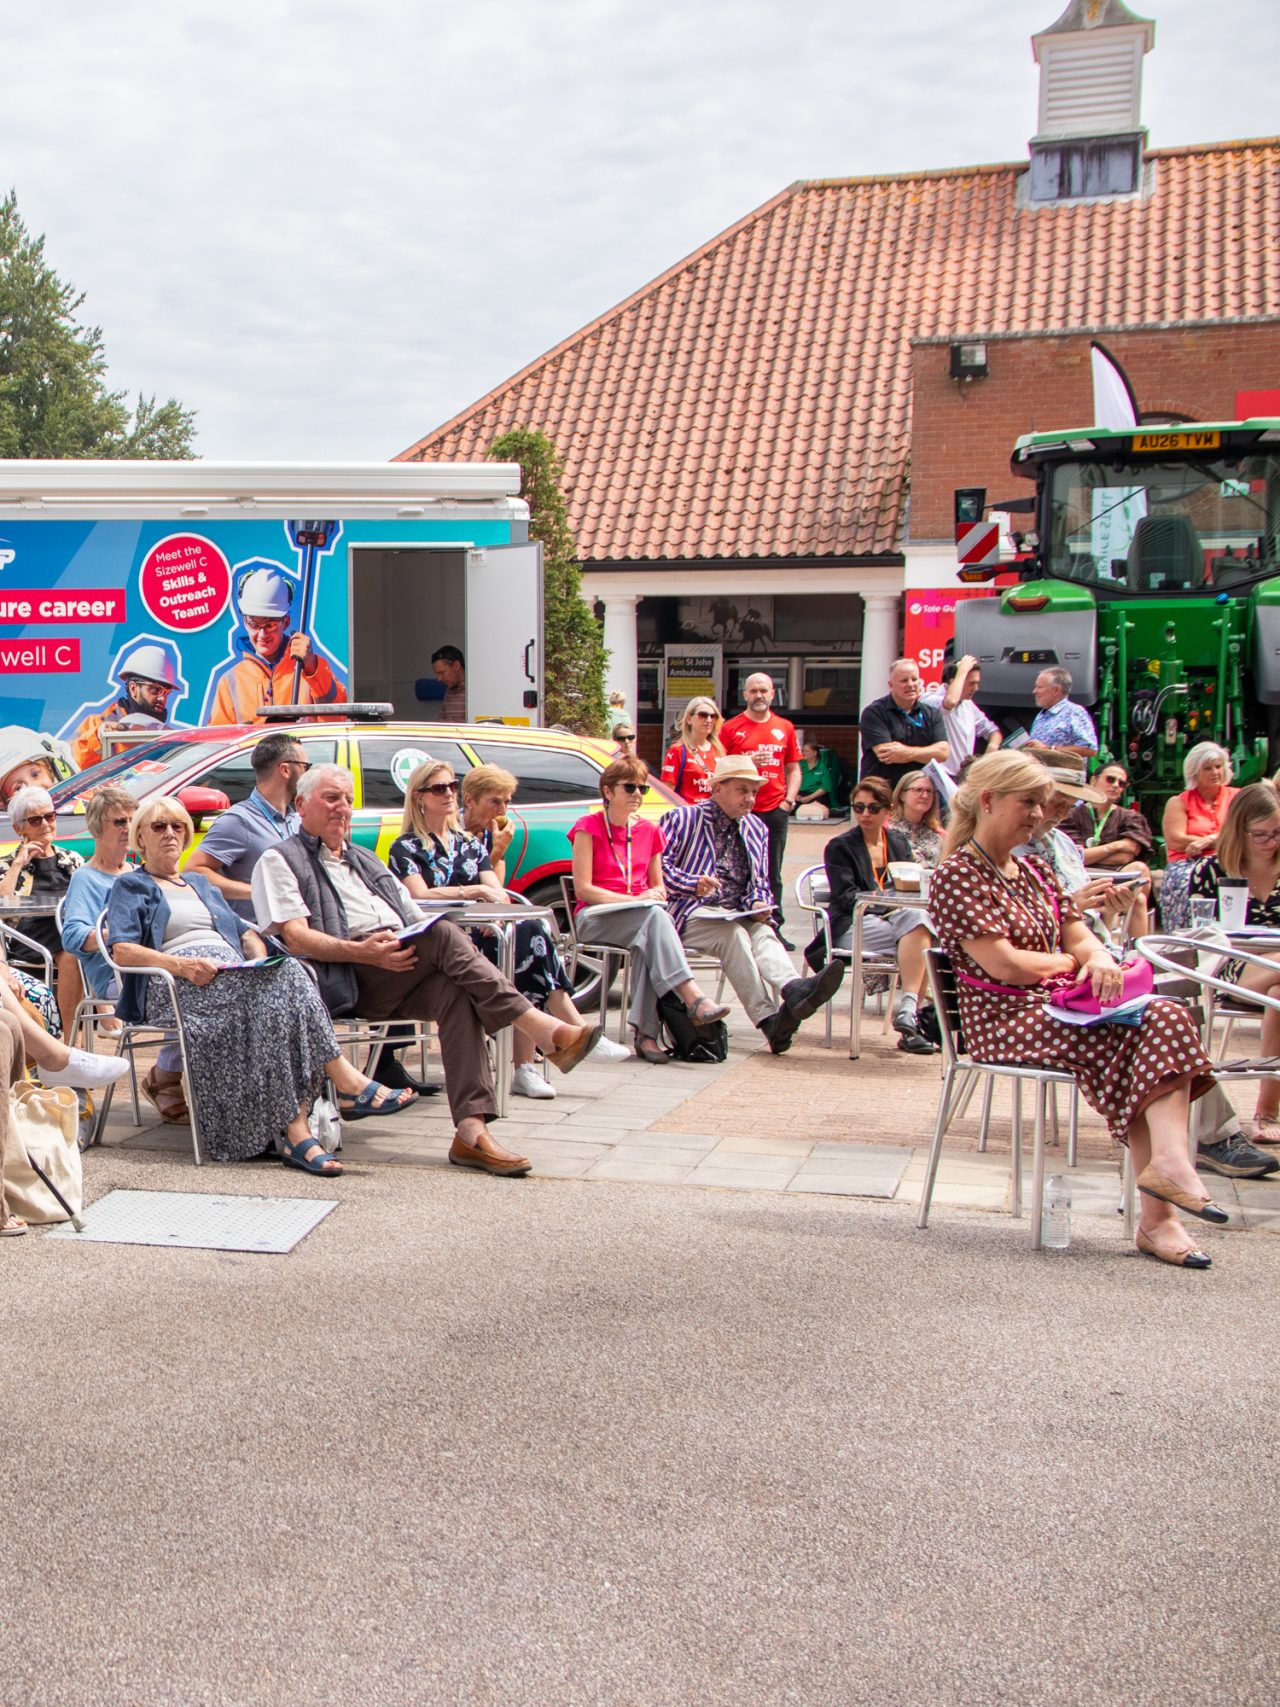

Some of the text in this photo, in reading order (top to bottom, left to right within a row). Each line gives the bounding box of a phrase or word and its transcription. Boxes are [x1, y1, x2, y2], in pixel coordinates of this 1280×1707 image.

[1139, 432, 1214, 449] AU26 TVM
[155, 546, 202, 563] Meet the
[155, 557, 208, 577] Sizewell C
[162, 572, 207, 591] Skills &
[159, 586, 216, 607] Outreach
[38, 600, 116, 617] career
[172, 602, 210, 620] Team!
[55, 645, 72, 665] C
[670, 658, 712, 666] Join St John
[669, 668, 710, 676] Ambulance
